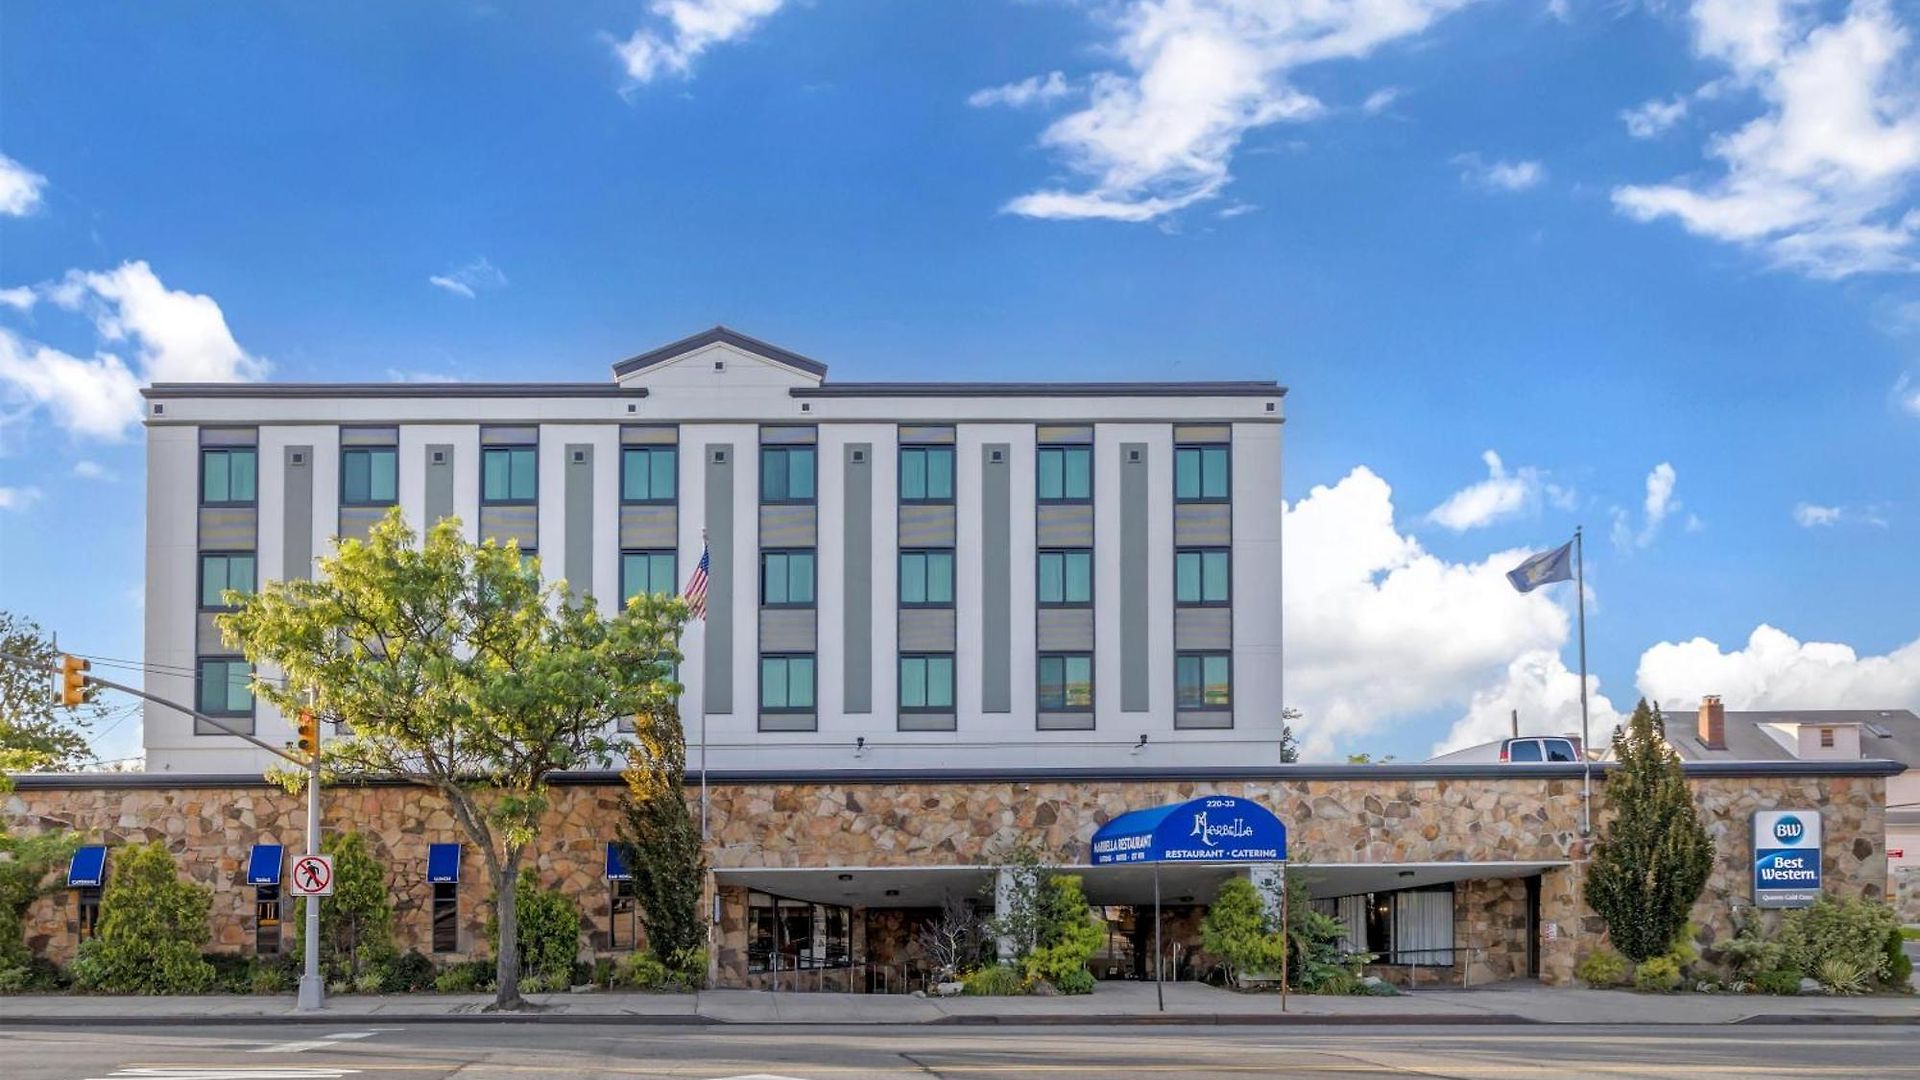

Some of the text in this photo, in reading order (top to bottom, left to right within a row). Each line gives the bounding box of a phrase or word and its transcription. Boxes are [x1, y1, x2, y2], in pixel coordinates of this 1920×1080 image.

[1777, 824, 1801, 837] BW
[1165, 849, 1277, 859] RESTAURANT CATERING
[1774, 857, 1803, 869] Best
[1761, 868, 1815, 880] Western
